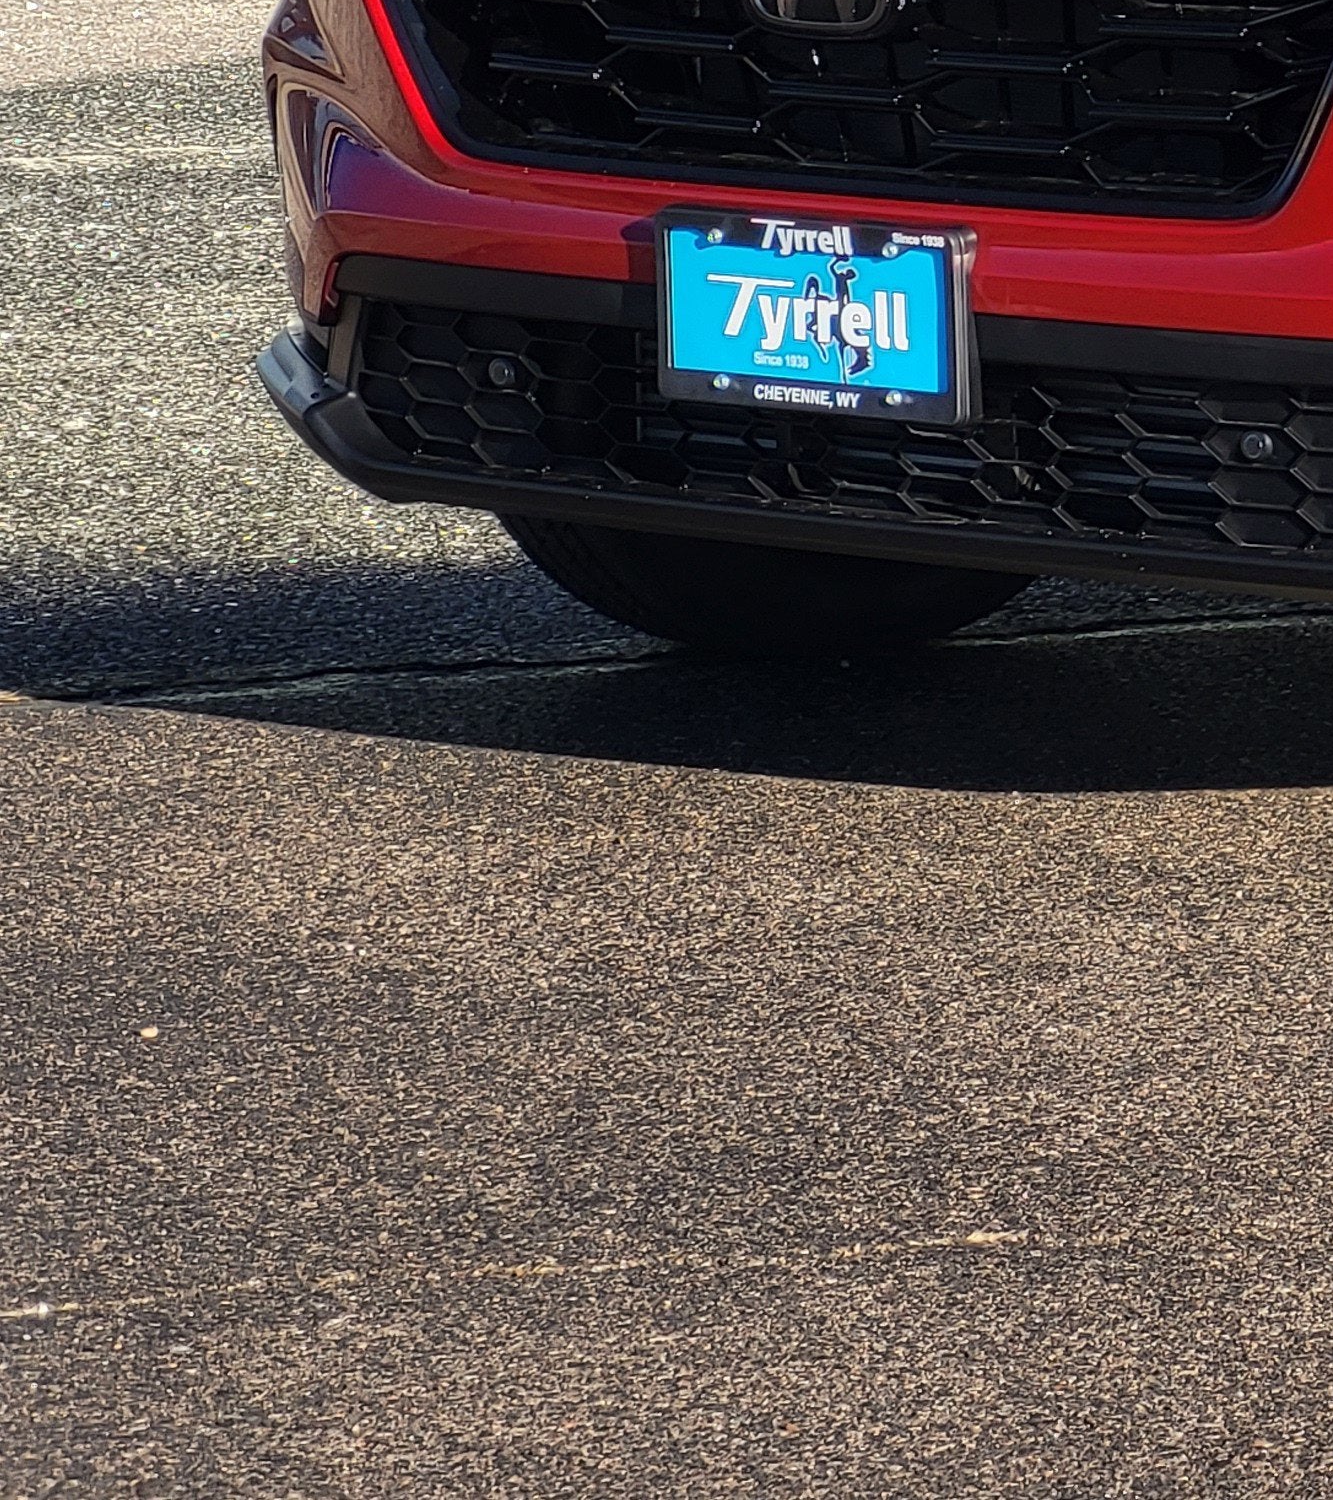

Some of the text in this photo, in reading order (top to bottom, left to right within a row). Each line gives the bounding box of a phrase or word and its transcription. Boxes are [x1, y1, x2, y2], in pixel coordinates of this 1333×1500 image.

[750, 217, 853, 256] Tyrrell
[891, 231, 945, 248] Since 1938
[706, 273, 909, 351] Tyrrell
[753, 351, 783, 367] Since
[753, 383, 861, 409] CHEYENNE, WY
